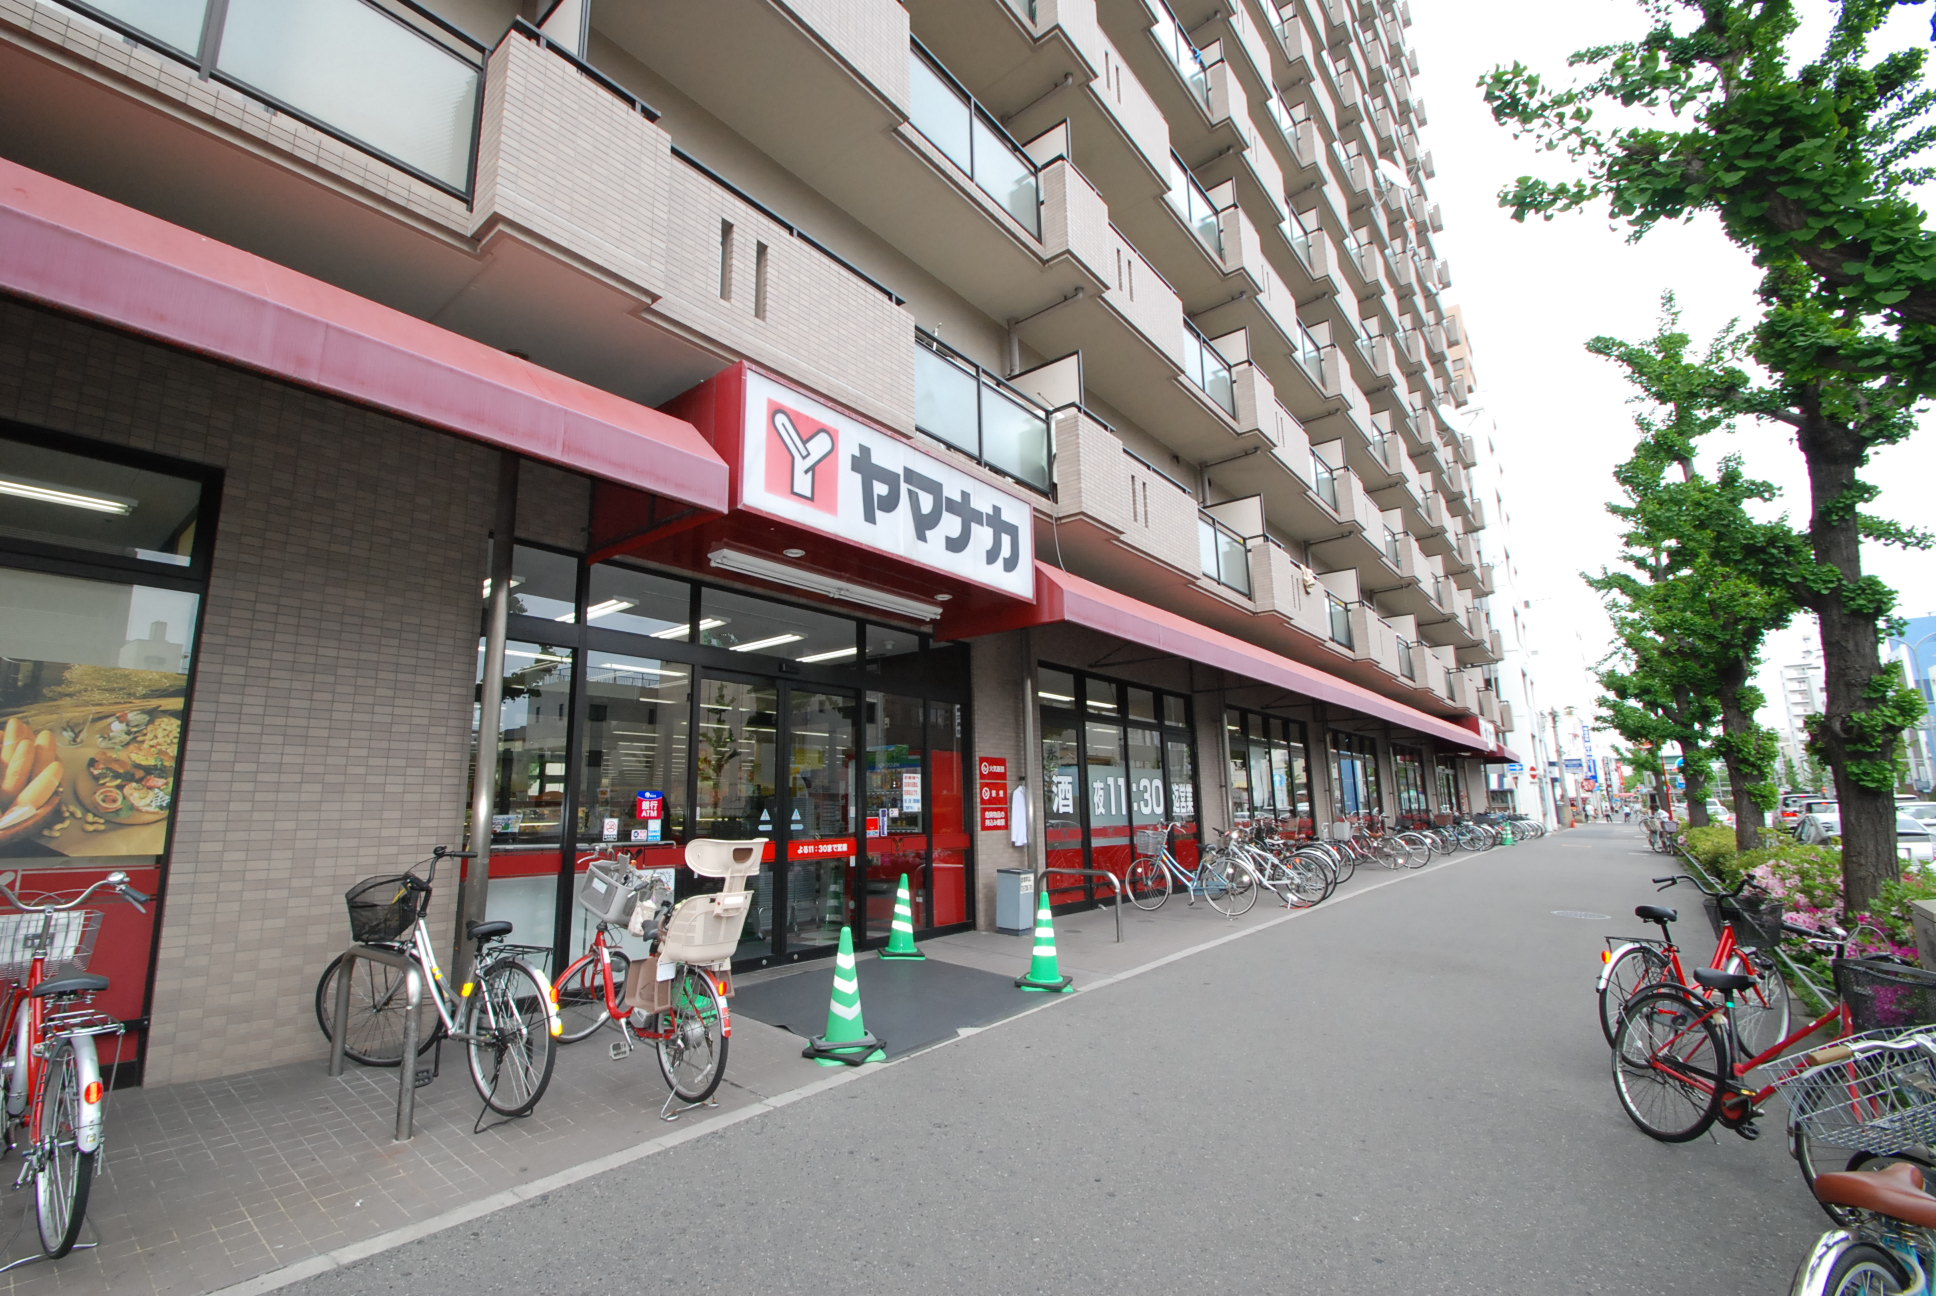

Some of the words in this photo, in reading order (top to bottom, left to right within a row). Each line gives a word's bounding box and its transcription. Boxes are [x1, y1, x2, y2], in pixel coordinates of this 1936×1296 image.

[850, 442, 1020, 574] ヤマナカ
[641, 801, 659, 810] 銀行
[1052, 775, 1074, 814] 酒
